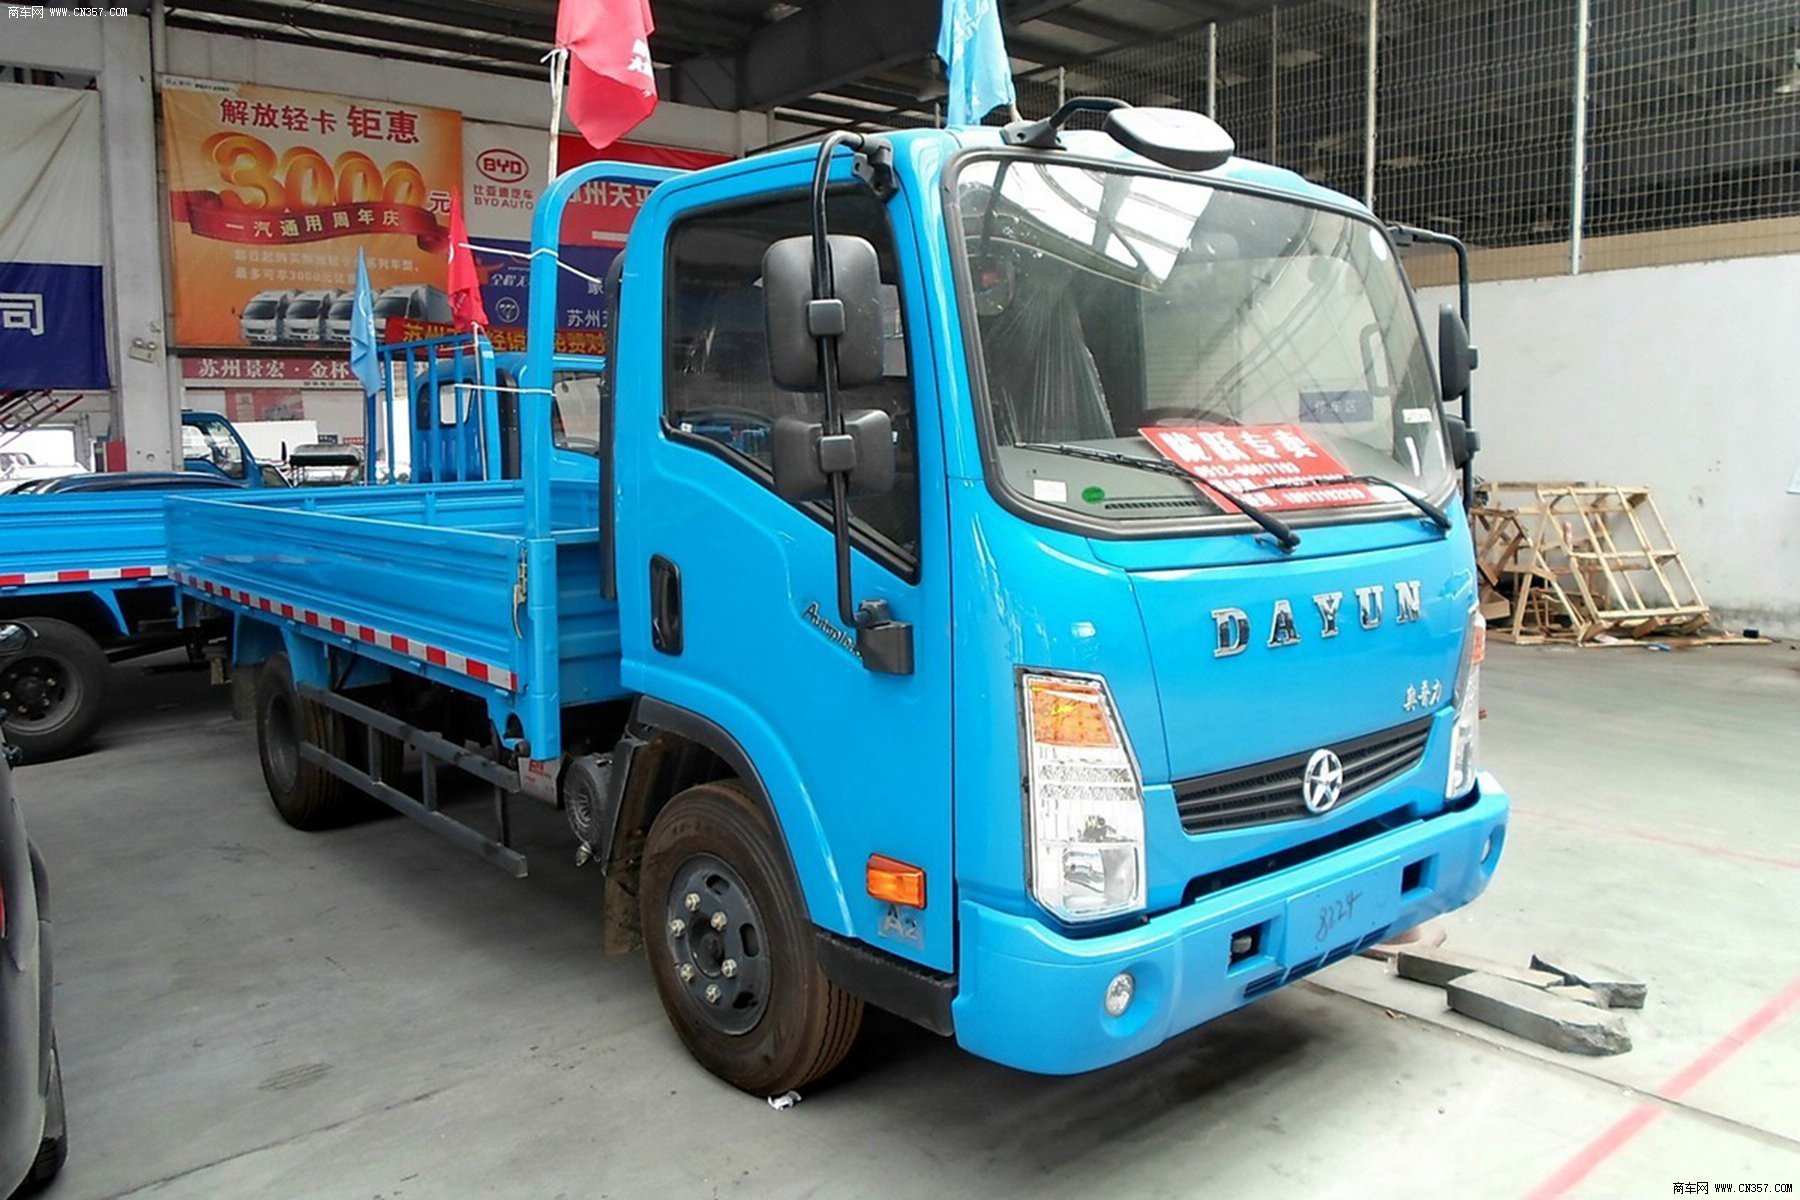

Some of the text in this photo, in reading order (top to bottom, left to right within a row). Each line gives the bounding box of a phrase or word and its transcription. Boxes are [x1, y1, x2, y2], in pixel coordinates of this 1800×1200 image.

[220, 99, 419, 144] 解放轻卡 钜惠
[483, 157, 522, 175] BYD
[473, 184, 534, 199] 比亚迪汽车
[225, 208, 401, 238] 一汽通用周年庆
[1211, 580, 1421, 658] DAYUN
